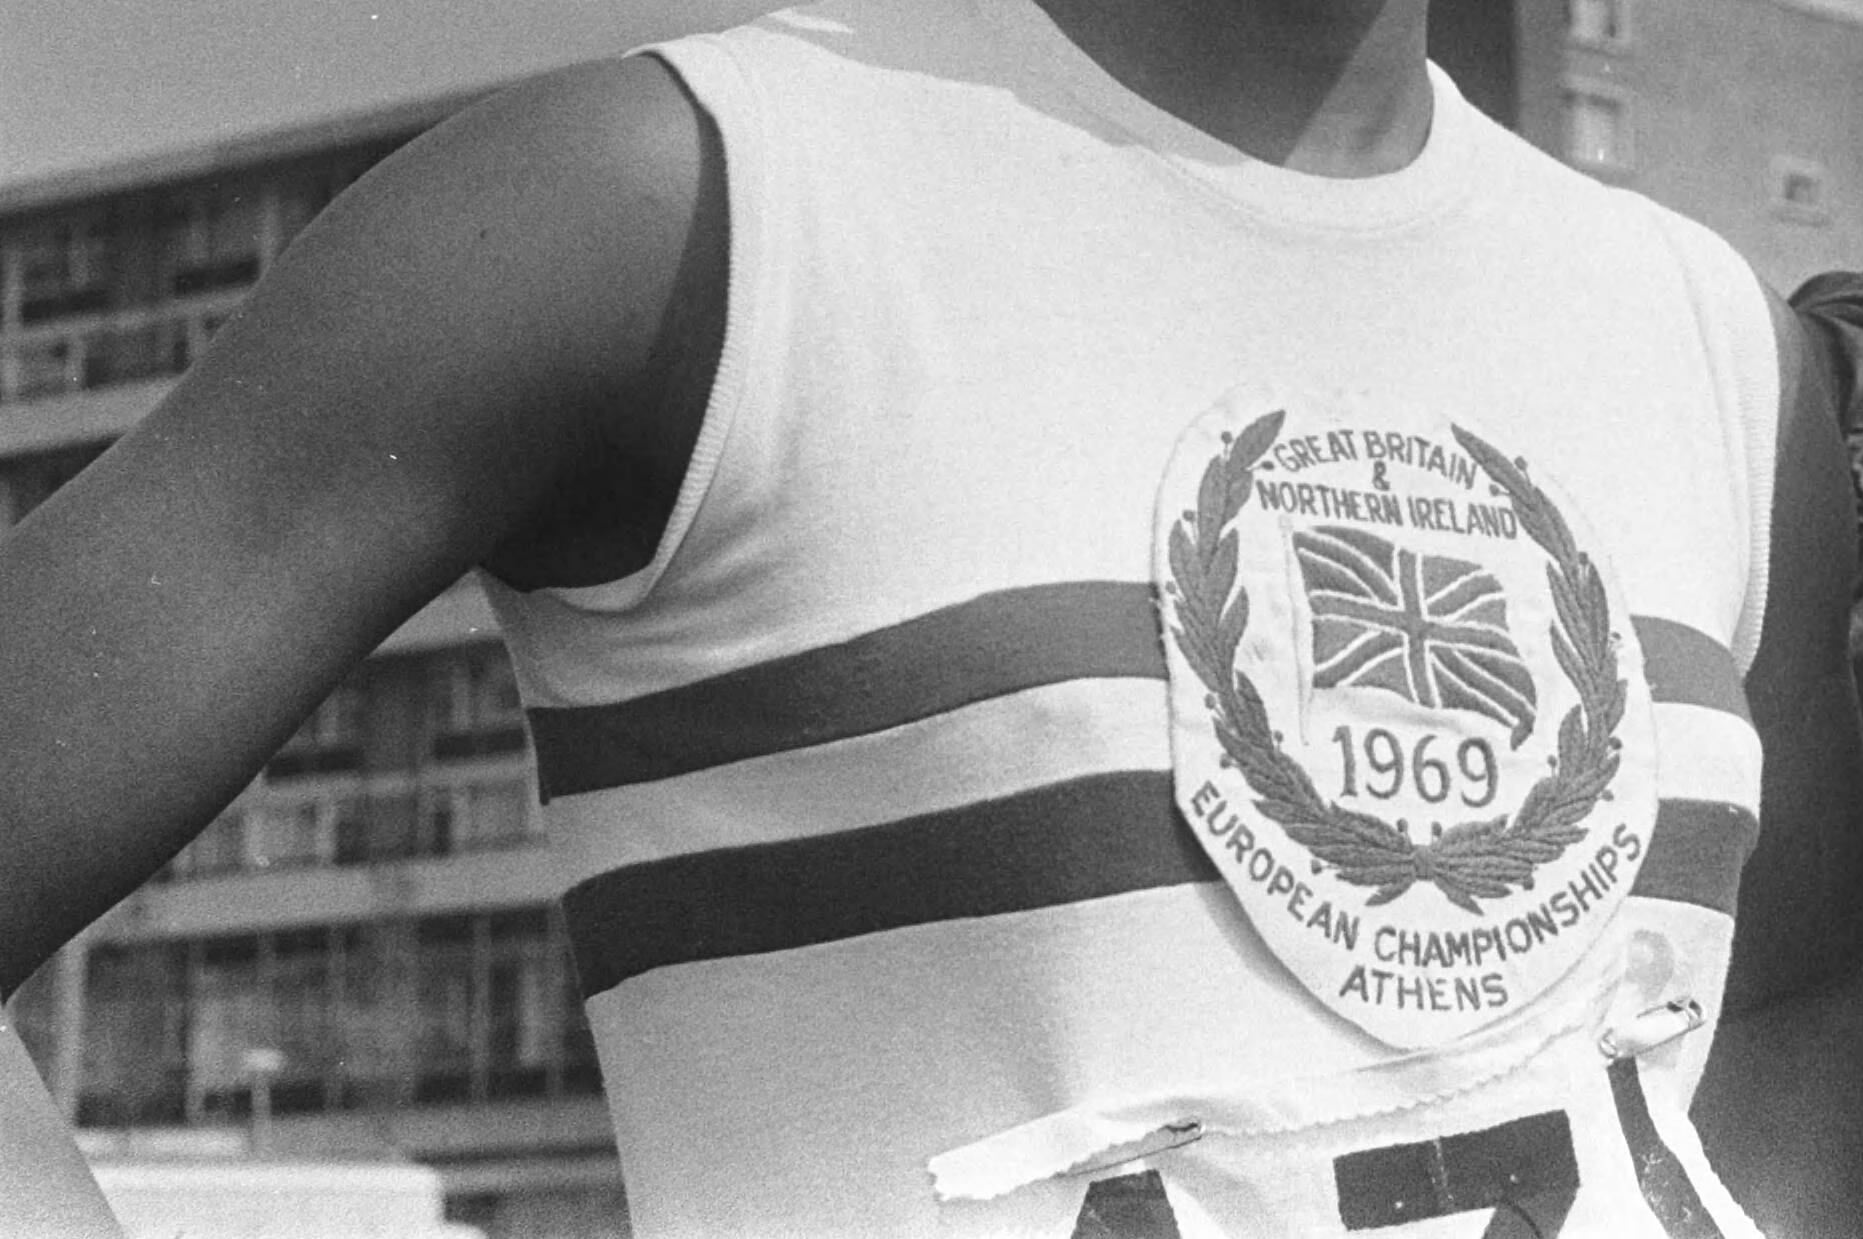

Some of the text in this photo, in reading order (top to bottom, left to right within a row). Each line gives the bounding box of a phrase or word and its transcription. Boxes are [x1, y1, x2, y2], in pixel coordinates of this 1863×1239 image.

[1273, 430, 1478, 490] GREAT BRITAIN
[1372, 461, 1391, 491] &
[1256, 480, 1518, 541] NORTHERN IRELAND
[1332, 725, 1499, 808] 1969
[1190, 781, 1642, 969] EUROPEAN CHAMPIONSHIPS
[1338, 964, 1509, 1012] ATHENS
